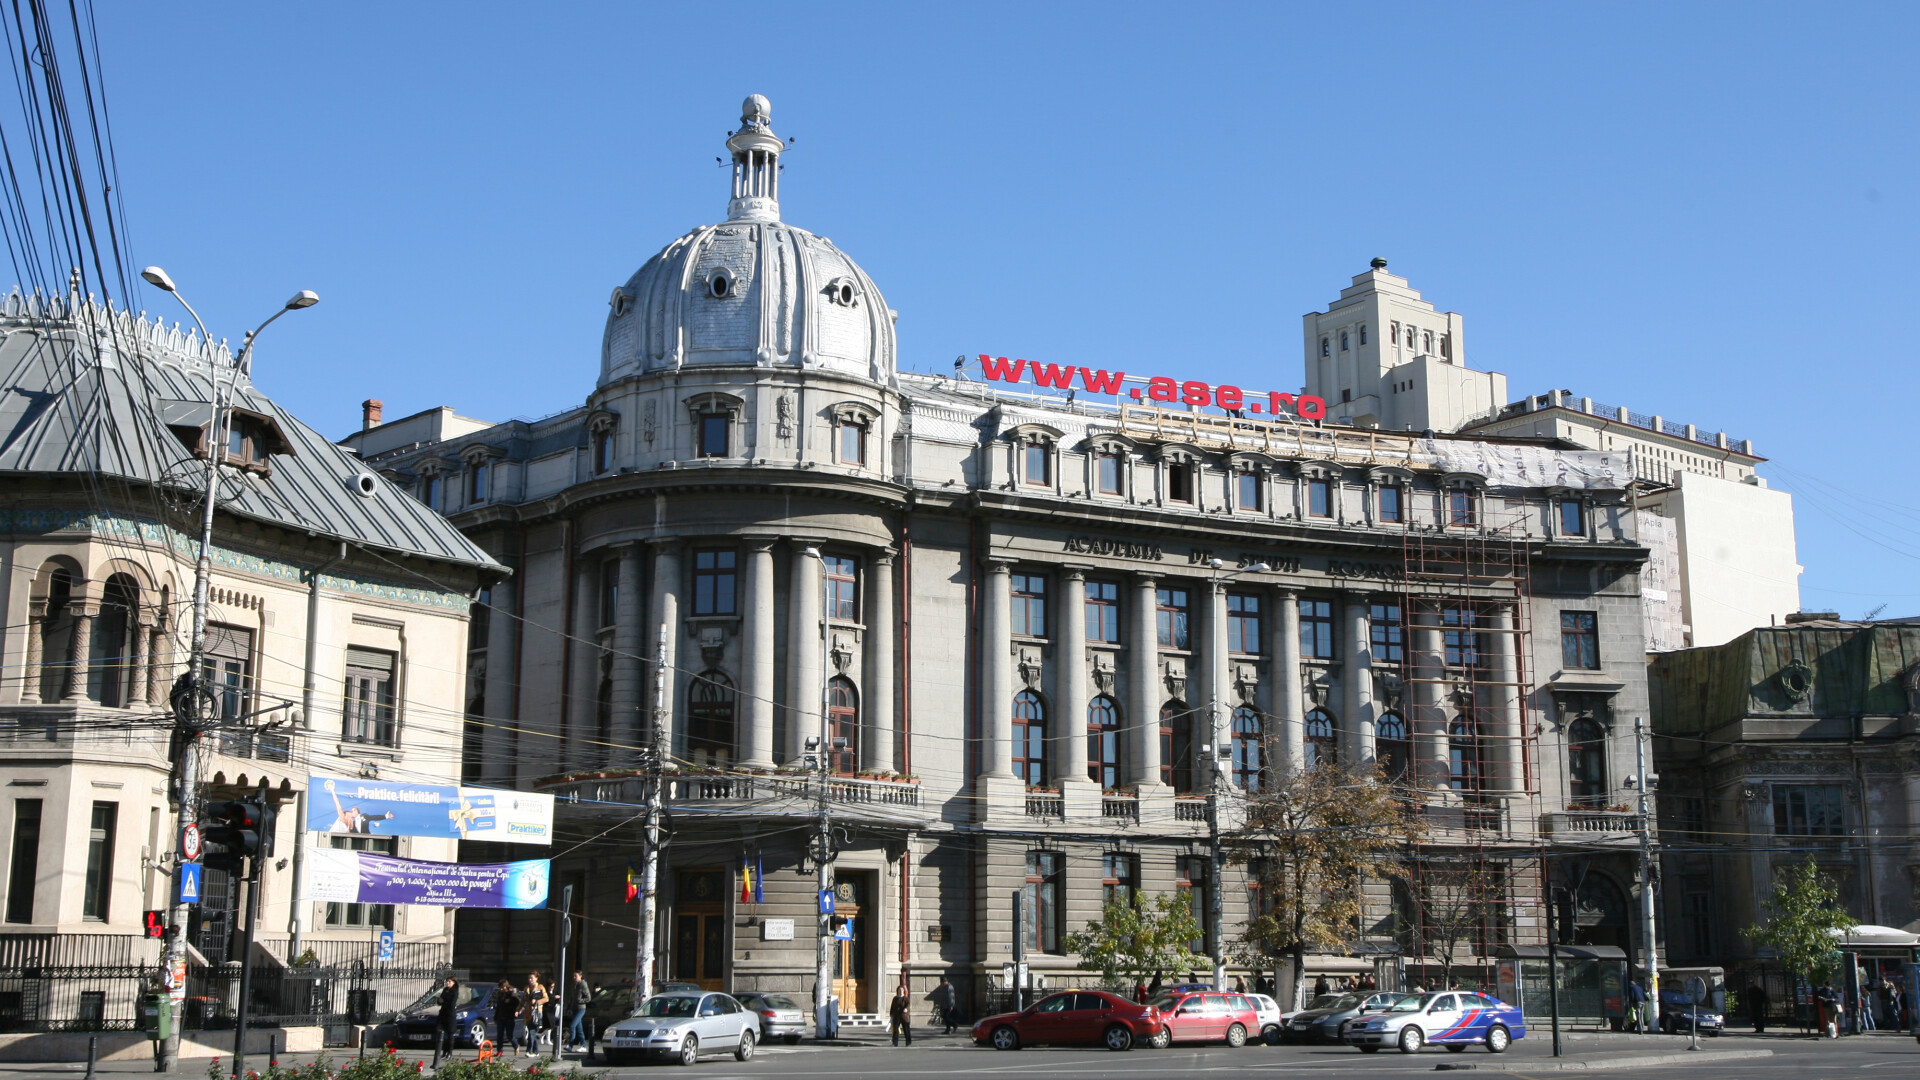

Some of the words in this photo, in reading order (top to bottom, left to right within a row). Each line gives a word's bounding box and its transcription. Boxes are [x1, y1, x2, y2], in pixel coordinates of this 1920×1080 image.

[979, 354, 1326, 420] www.ase.ro
[1513, 447, 1527, 480] Apla
[1600, 456, 1616, 487] Apla
[1065, 536, 1164, 562] ACADEMIA
[1190, 549, 1215, 567] DE
[510, 823, 545, 835] Praktiker
[460, 876, 469, 888] de
